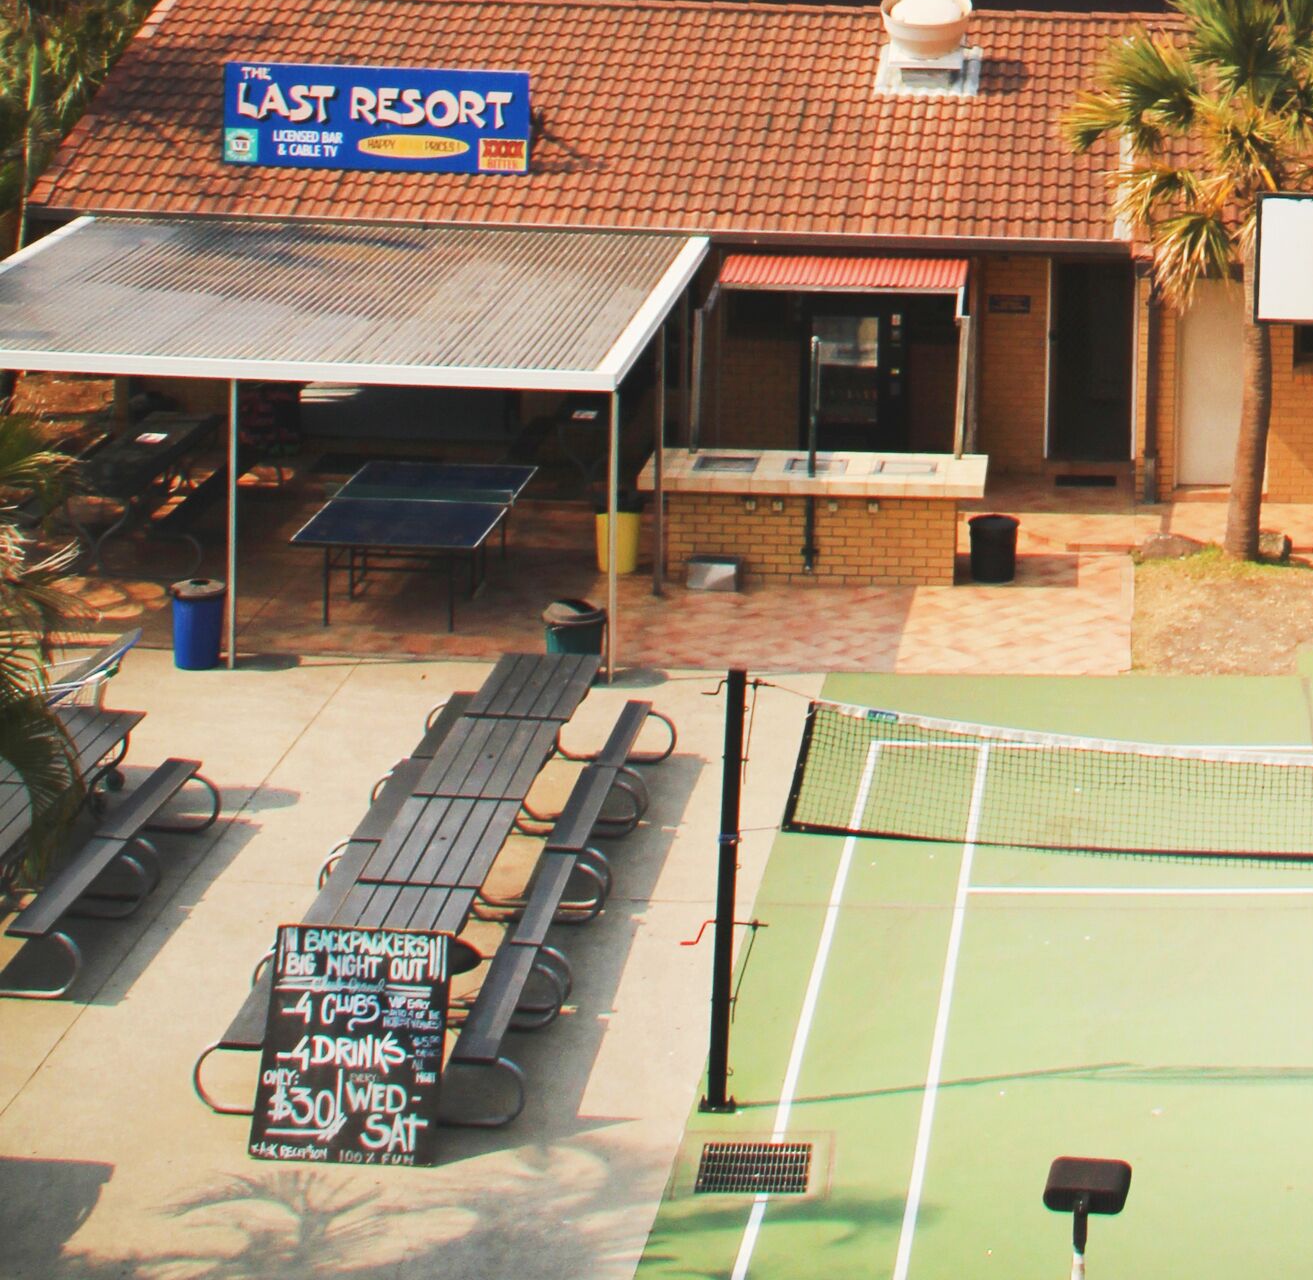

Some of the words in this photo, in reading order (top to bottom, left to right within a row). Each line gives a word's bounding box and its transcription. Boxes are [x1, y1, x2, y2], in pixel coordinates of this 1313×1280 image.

[241, 66, 273, 81] THE
[237, 82, 336, 124] LAST
[351, 85, 513, 130] RESORT
[272, 129, 320, 144] LICENSED
[321, 131, 344, 144] BAR
[277, 143, 287, 156] &
[288, 144, 322, 157] CABLE
[323, 145, 339, 158] TV
[367, 139, 396, 151] HAPPY
[304, 929, 429, 958] BACKPACKERS
[285, 951, 317, 976] BIG
[327, 953, 383, 979] NIGHT
[390, 956, 428, 982] OUT
[321, 992, 381, 1031] CLUBS
[310, 1030, 407, 1074] DRINKS
[267, 1083, 335, 1128] $30
[345, 1081, 407, 1113] WED
[360, 1113, 429, 1153] SAT
